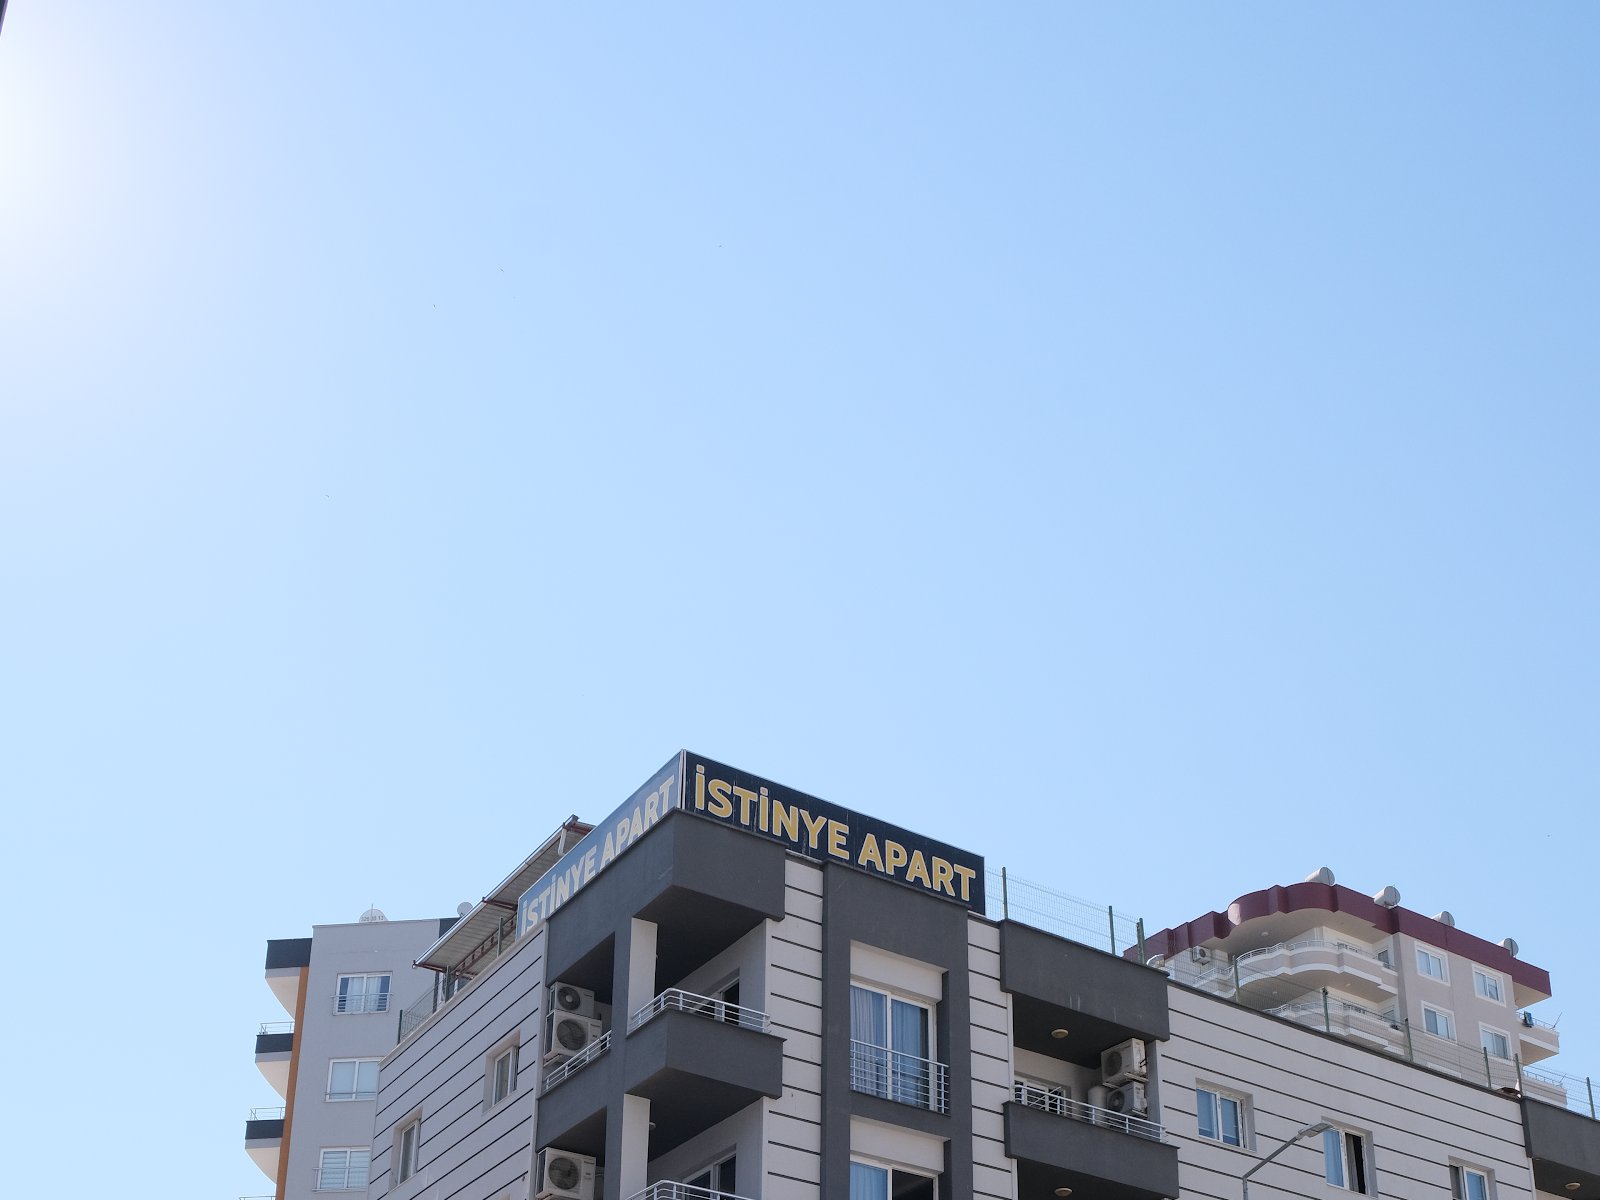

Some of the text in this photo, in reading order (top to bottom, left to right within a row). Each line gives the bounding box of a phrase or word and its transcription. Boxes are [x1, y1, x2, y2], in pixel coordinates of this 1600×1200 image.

[520, 774, 675, 937] İSTİNYE APART
[694, 764, 977, 903] İSTİNYE APART
